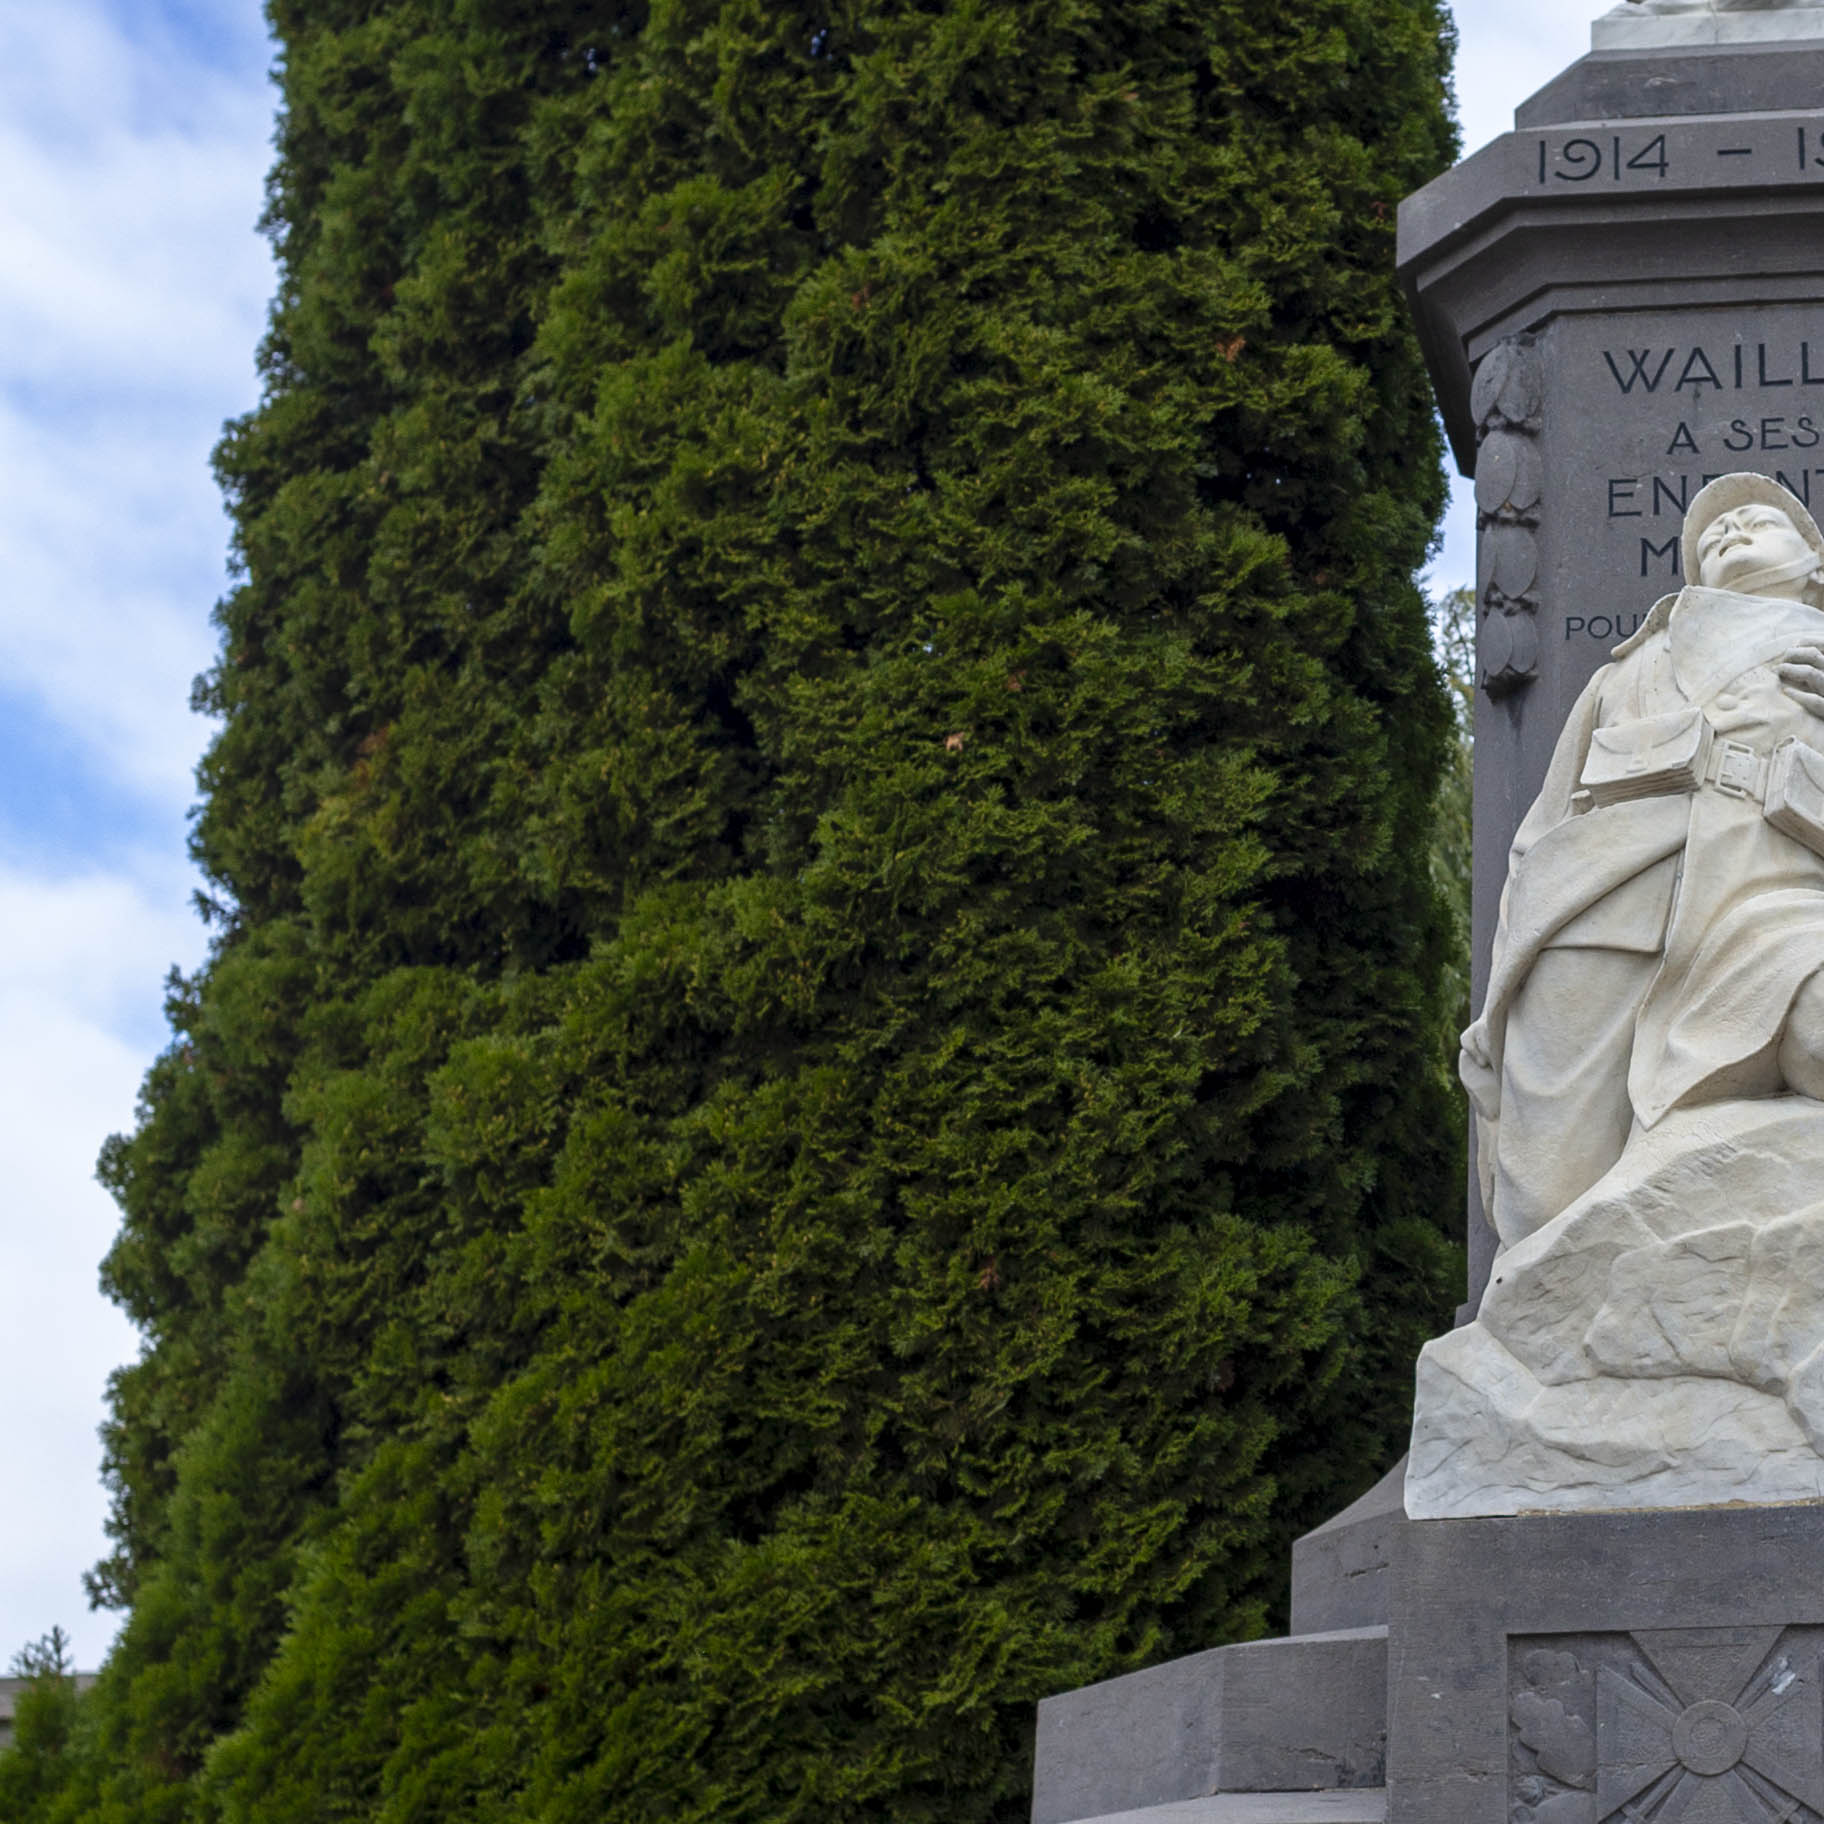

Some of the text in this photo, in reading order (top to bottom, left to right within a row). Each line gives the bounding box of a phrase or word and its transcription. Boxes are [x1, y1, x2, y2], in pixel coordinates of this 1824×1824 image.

[1538, 133, 1670, 185] 1914
[1665, 417, 1821, 455] A SES
[1564, 613, 1648, 641] POU
